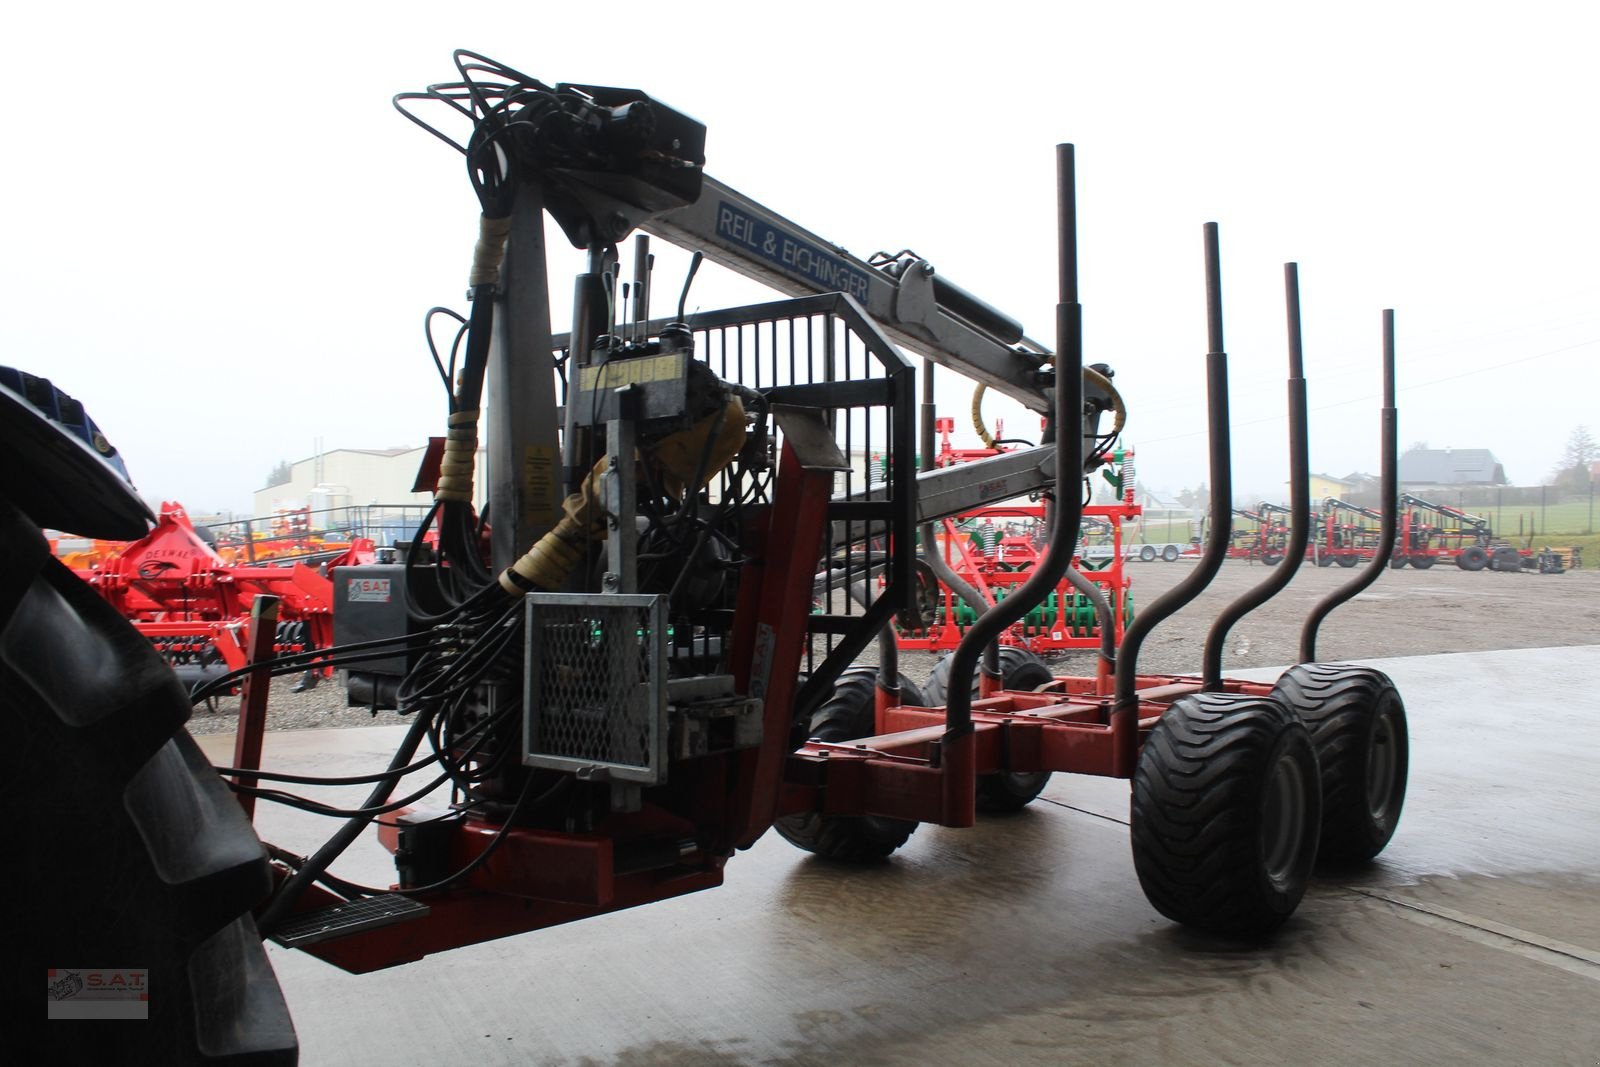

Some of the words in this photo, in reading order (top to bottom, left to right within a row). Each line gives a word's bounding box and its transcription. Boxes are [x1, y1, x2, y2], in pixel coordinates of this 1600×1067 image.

[719, 208, 757, 247] REIL
[762, 231, 777, 257] &
[782, 239, 869, 298] EICHINGER
